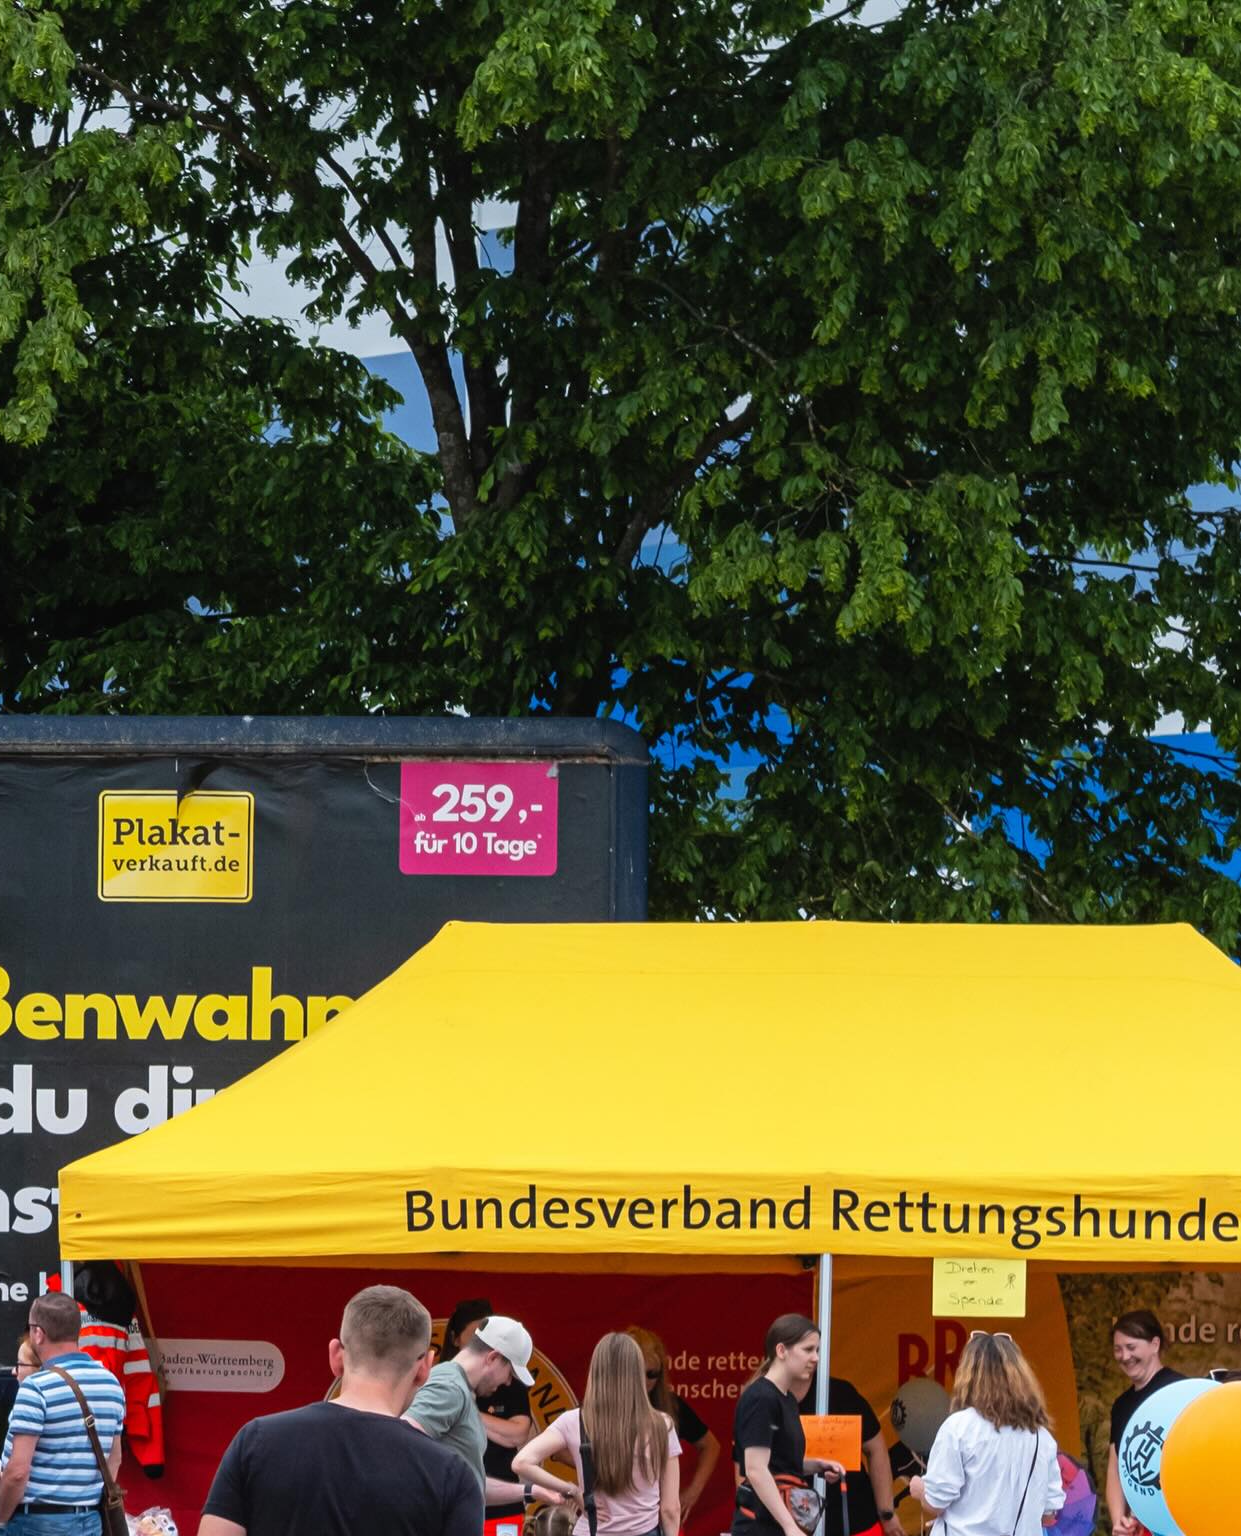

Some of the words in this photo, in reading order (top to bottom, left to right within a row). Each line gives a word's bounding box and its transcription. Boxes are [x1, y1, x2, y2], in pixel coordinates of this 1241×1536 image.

[414, 813, 426, 822] ab
[112, 818, 240, 846] Plakat-
[414, 831, 448, 854] für
[453, 832, 478, 854] 10
[112, 855, 240, 872] verkauft.de
[114, 1065, 226, 1134] di
[405, 1184, 812, 1232] Bundesverband
[832, 1188, 1240, 1250] Rettungshunde
